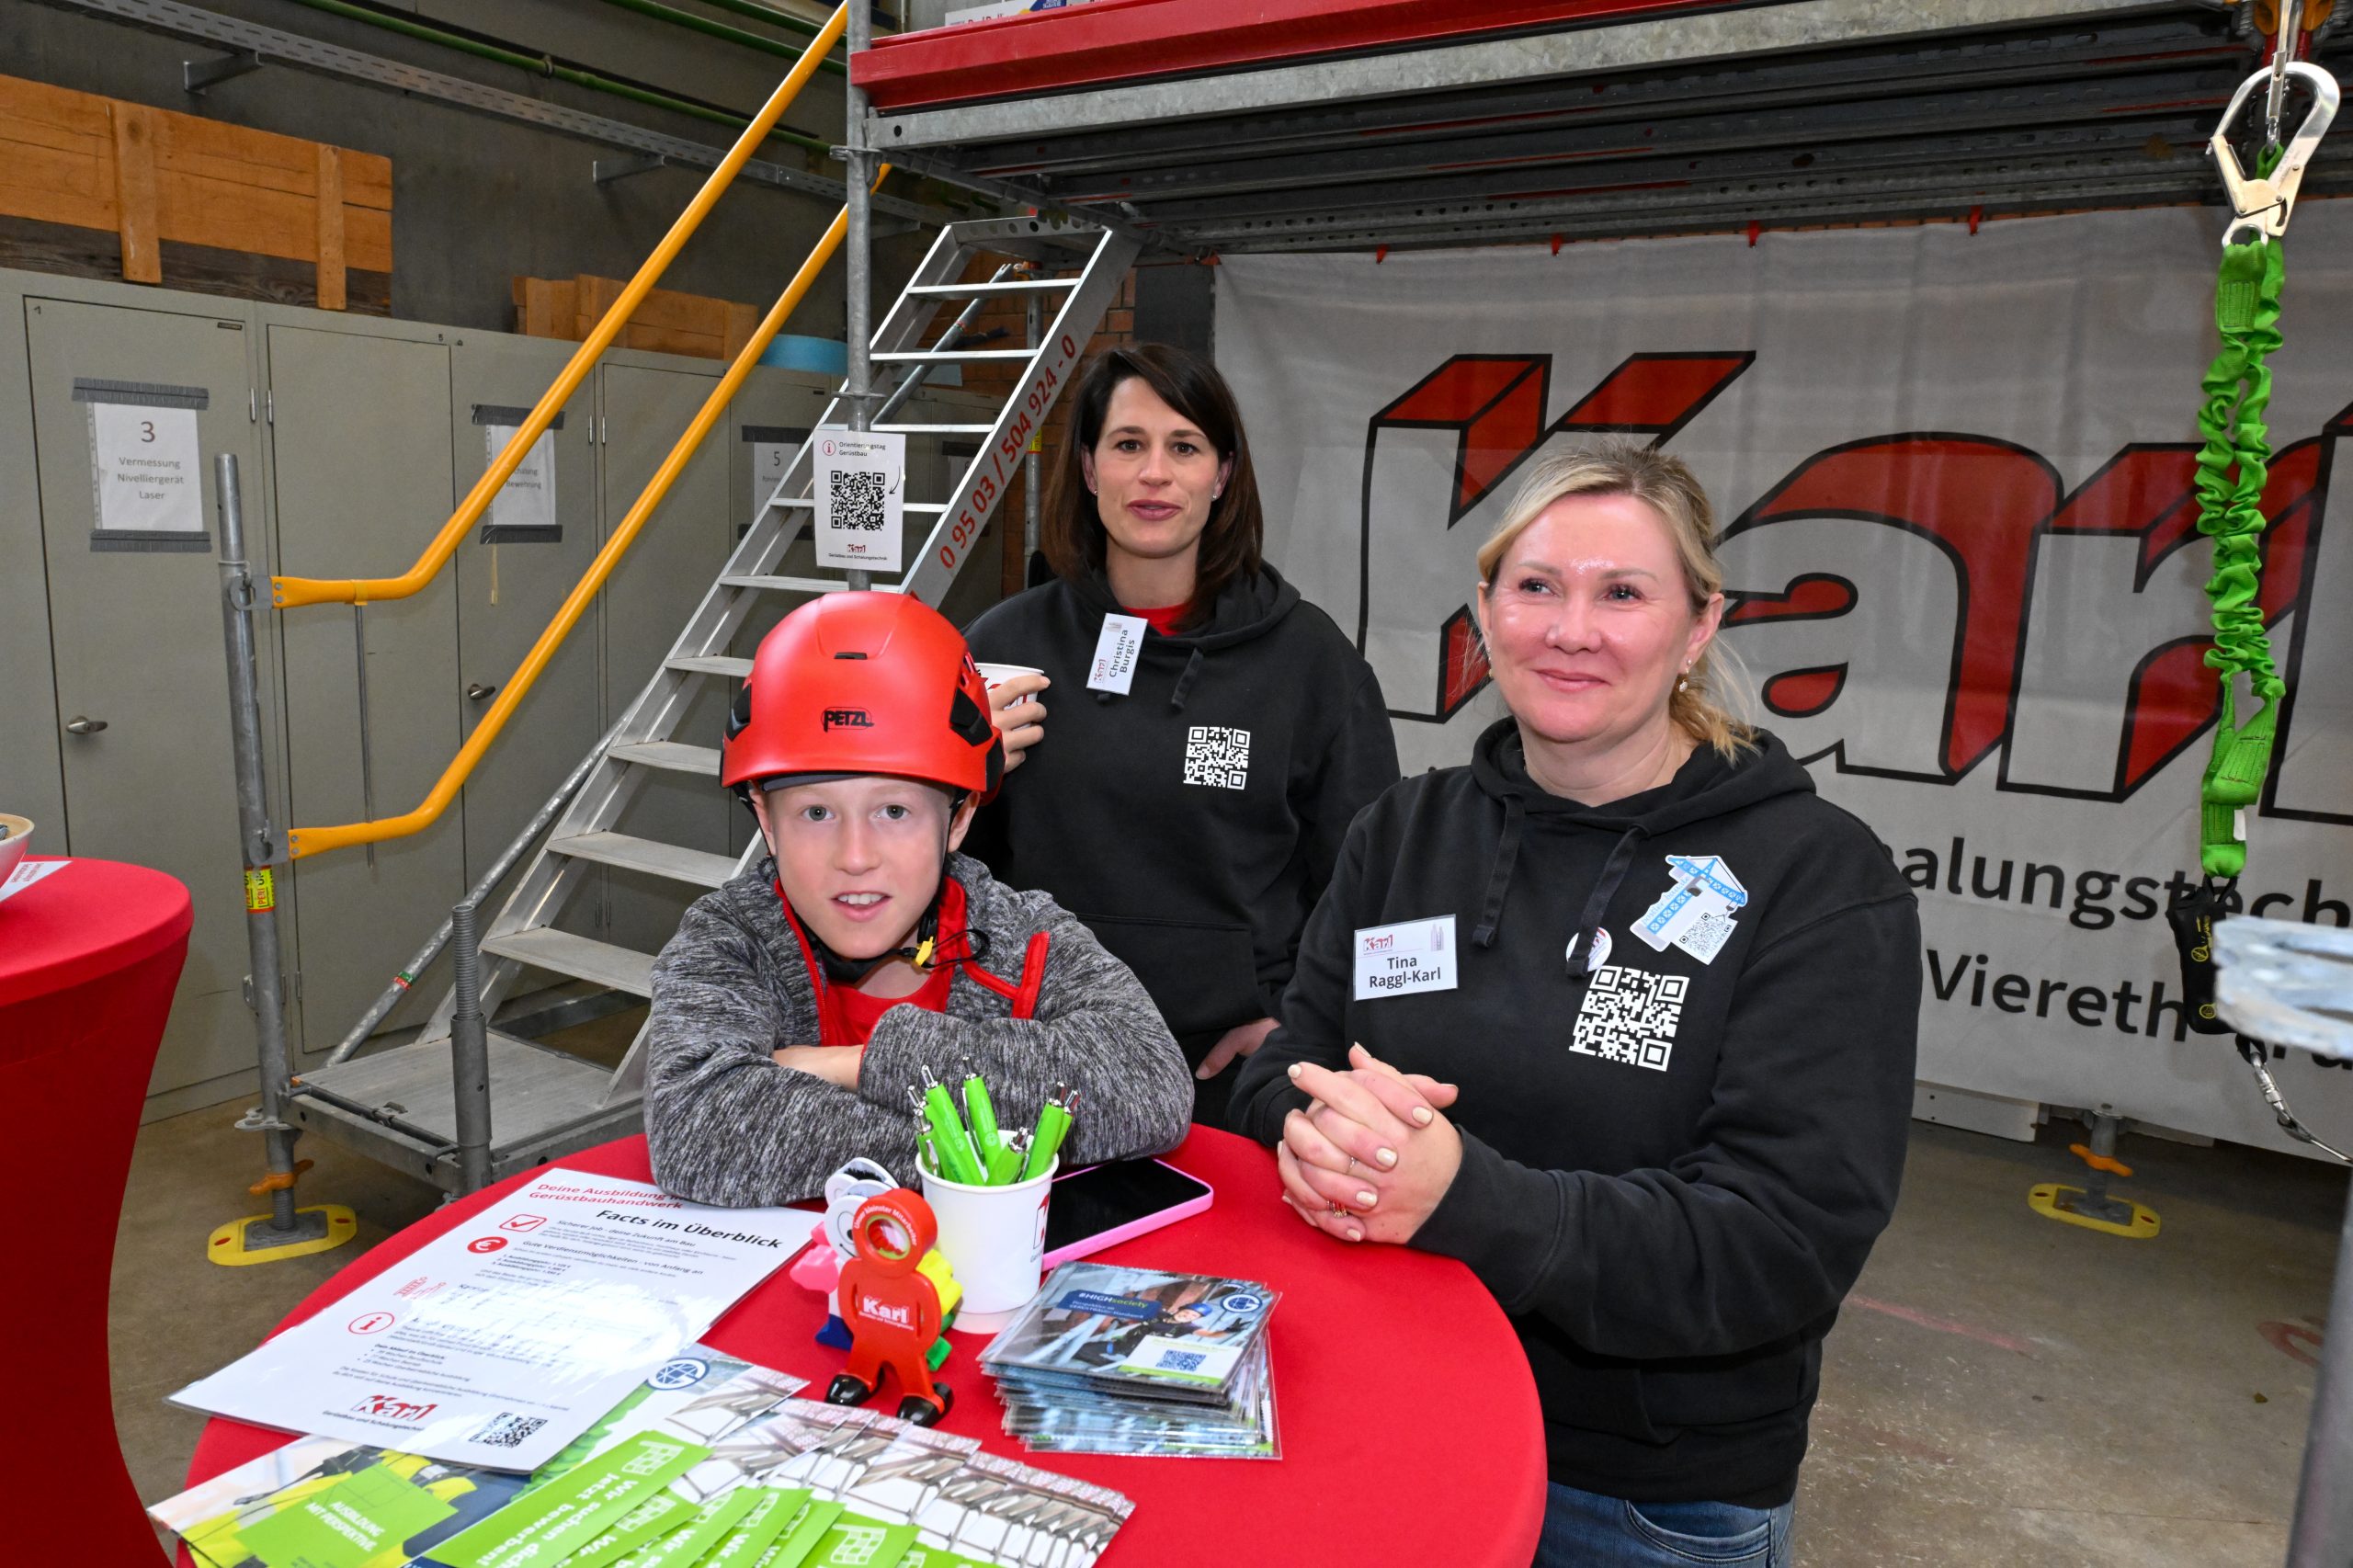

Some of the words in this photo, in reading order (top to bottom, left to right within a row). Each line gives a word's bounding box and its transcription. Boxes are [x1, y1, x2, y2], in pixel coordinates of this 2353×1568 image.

[141, 421, 155, 443] 3
[839, 442, 886, 450] Orientierungstag
[939, 546, 956, 569] 0
[951, 510, 976, 549] 95
[972, 475, 996, 513] 03
[993, 453, 1005, 486] /
[1001, 411, 1031, 463] 504
[1028, 367, 1058, 416] 924
[1062, 335, 1075, 358] 0
[119, 457, 181, 470] Vermessung
[773, 451, 780, 466] 5
[118, 473, 185, 486] Nivelliergerät
[139, 490, 165, 500] Laser
[1109, 630, 1128, 677] Christina
[1120, 640, 1135, 673] Burgis
[824, 710, 874, 733] PETZL
[1363, 934, 1393, 950] Karl
[1387, 956, 1416, 970] Tina
[1370, 966, 1440, 989] Raggl-Karl
[529, 1192, 683, 1209] Gerüstbauhandwerk
[538, 1184, 580, 1194] Deine
[583, 1187, 665, 1200] Ausbildung
[596, 1210, 650, 1225] Facts
[653, 1218, 679, 1231] im
[684, 1222, 783, 1249] Überblick
[863, 1295, 909, 1324] Karl
[1078, 1291, 1150, 1309] #HIGHsociety
[350, 1394, 438, 1422] Karl
[576, 1472, 620, 1501] Jetzt
[606, 1480, 639, 1501] Wir
[304, 1502, 327, 1517] MIT
[318, 1510, 378, 1552] PERSPEKTIVE
[329, 1500, 385, 1537] AUSBILDUNG
[541, 1501, 602, 1541] suchen
[476, 1503, 576, 1566] bewerben!
[663, 1528, 696, 1553] Wir
[719, 1533, 750, 1559] Wir
